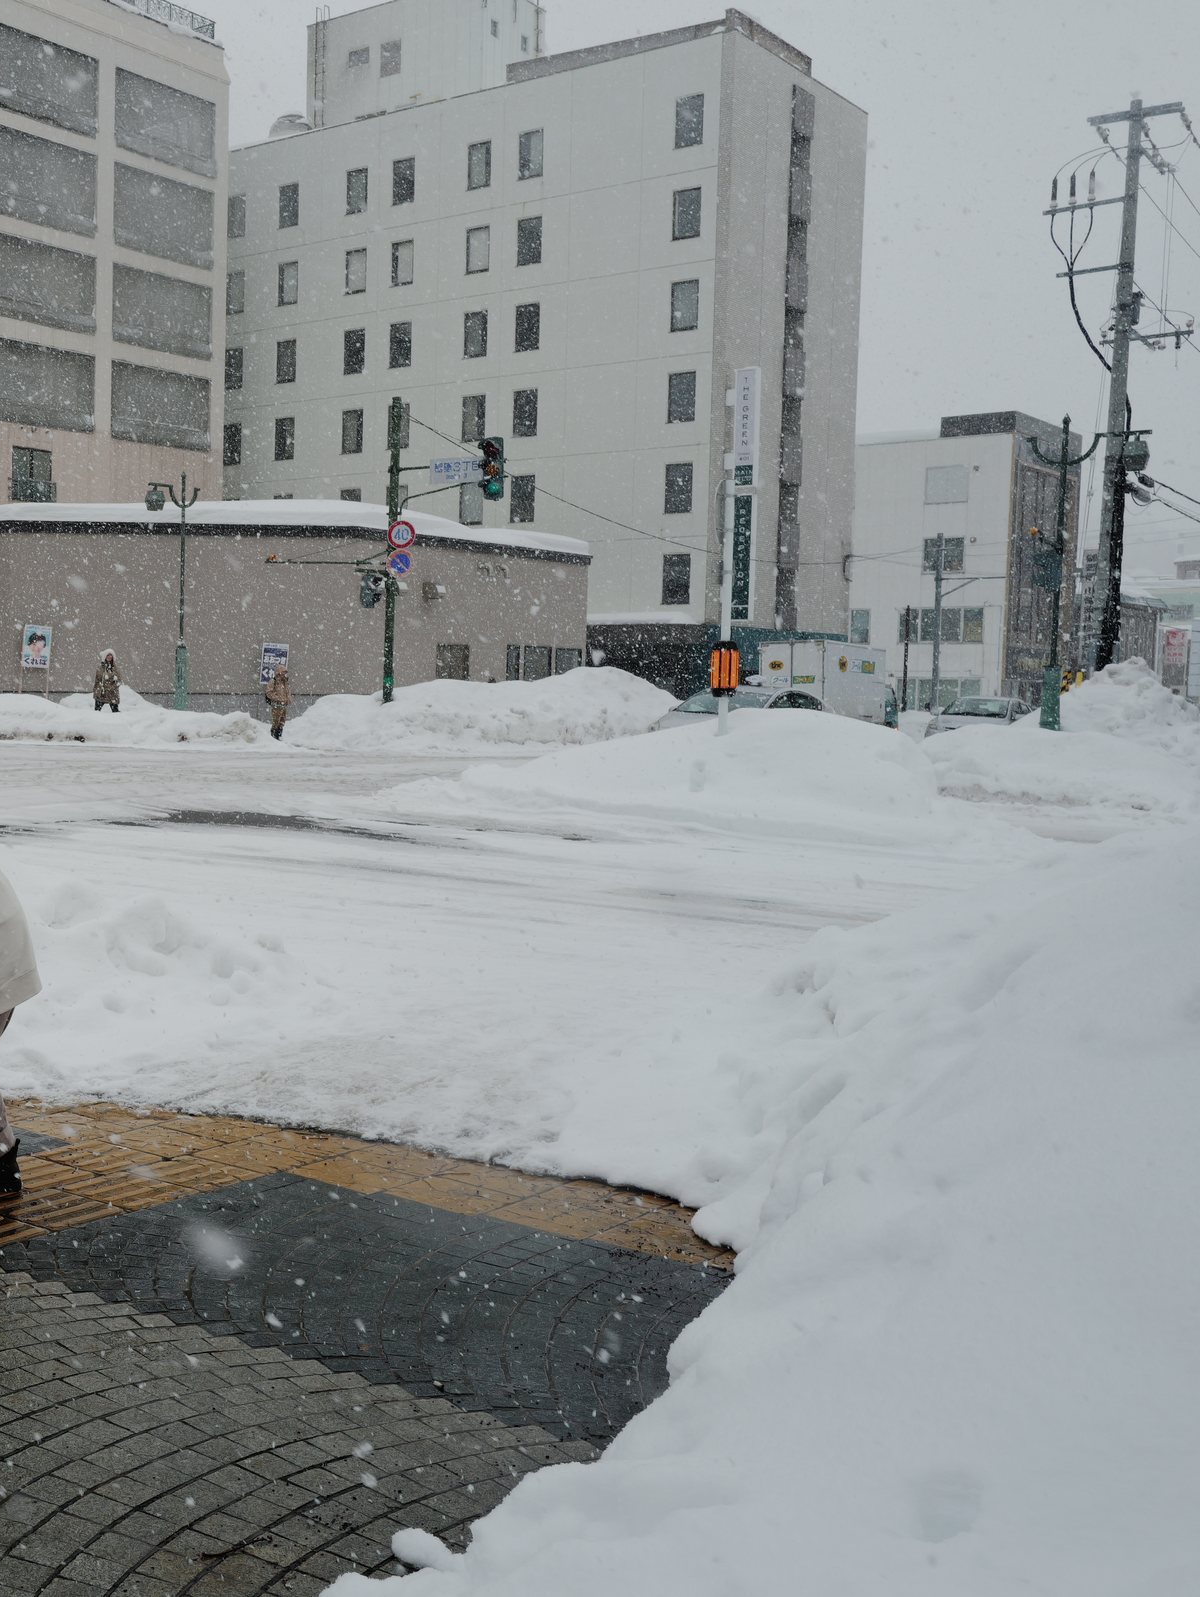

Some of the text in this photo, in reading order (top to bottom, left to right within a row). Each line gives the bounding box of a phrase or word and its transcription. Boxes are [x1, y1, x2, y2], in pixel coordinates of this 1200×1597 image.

[742, 377, 750, 401] THE
[741, 405, 750, 446] GREEN
[393, 528, 409, 540] 40
[737, 508, 746, 587] RECEPTION
[262, 668, 276, 678] くれ
